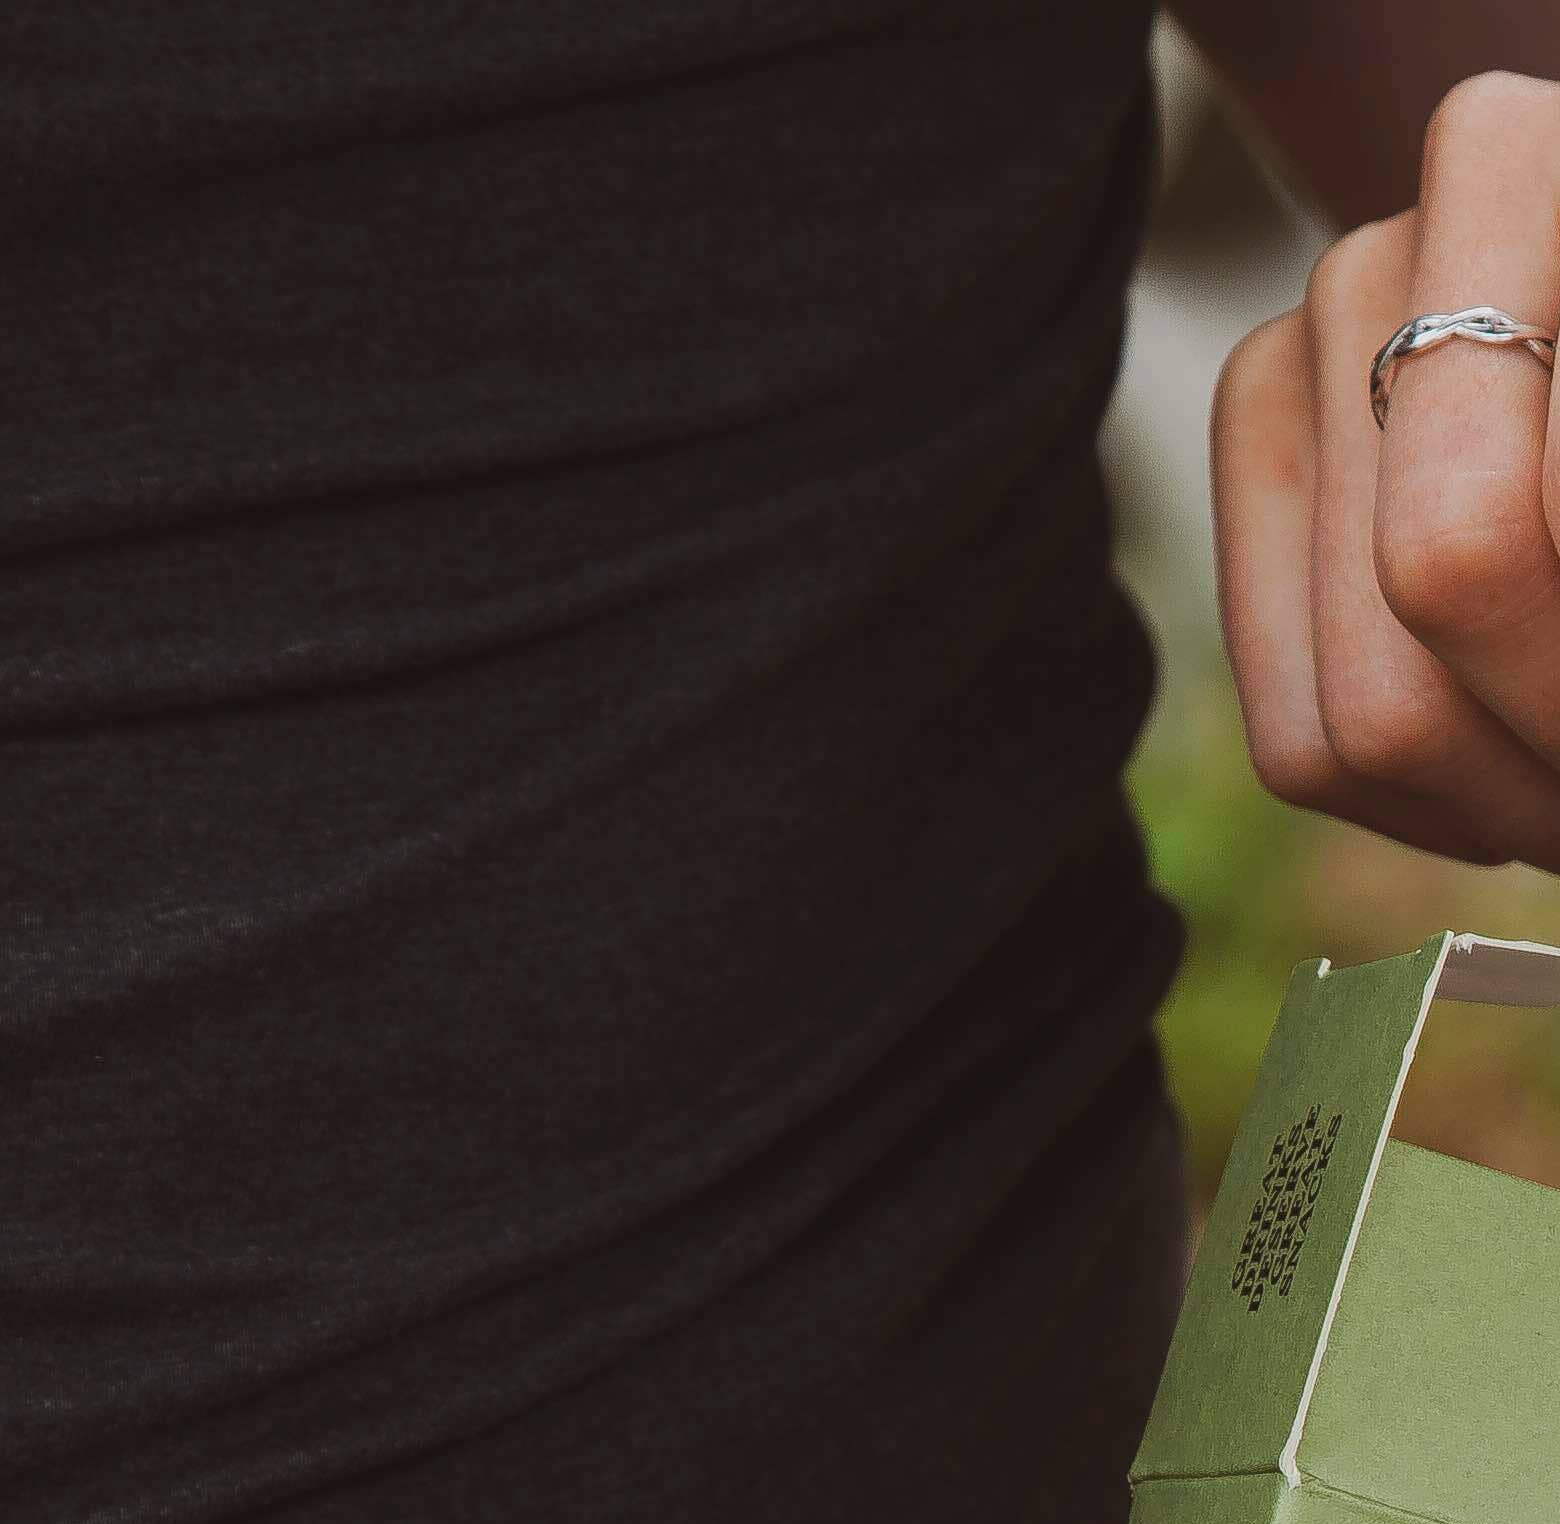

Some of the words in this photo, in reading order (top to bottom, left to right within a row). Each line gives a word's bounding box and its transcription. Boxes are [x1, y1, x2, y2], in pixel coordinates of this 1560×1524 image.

[1232, 1133, 1285, 1290] GREAT
[1240, 1122, 1303, 1296] DRINKS
[1248, 1103, 1321, 1311] DESERVE
[1270, 1128, 1324, 1285] GREAT
[1278, 1114, 1342, 1296] SNACKS
